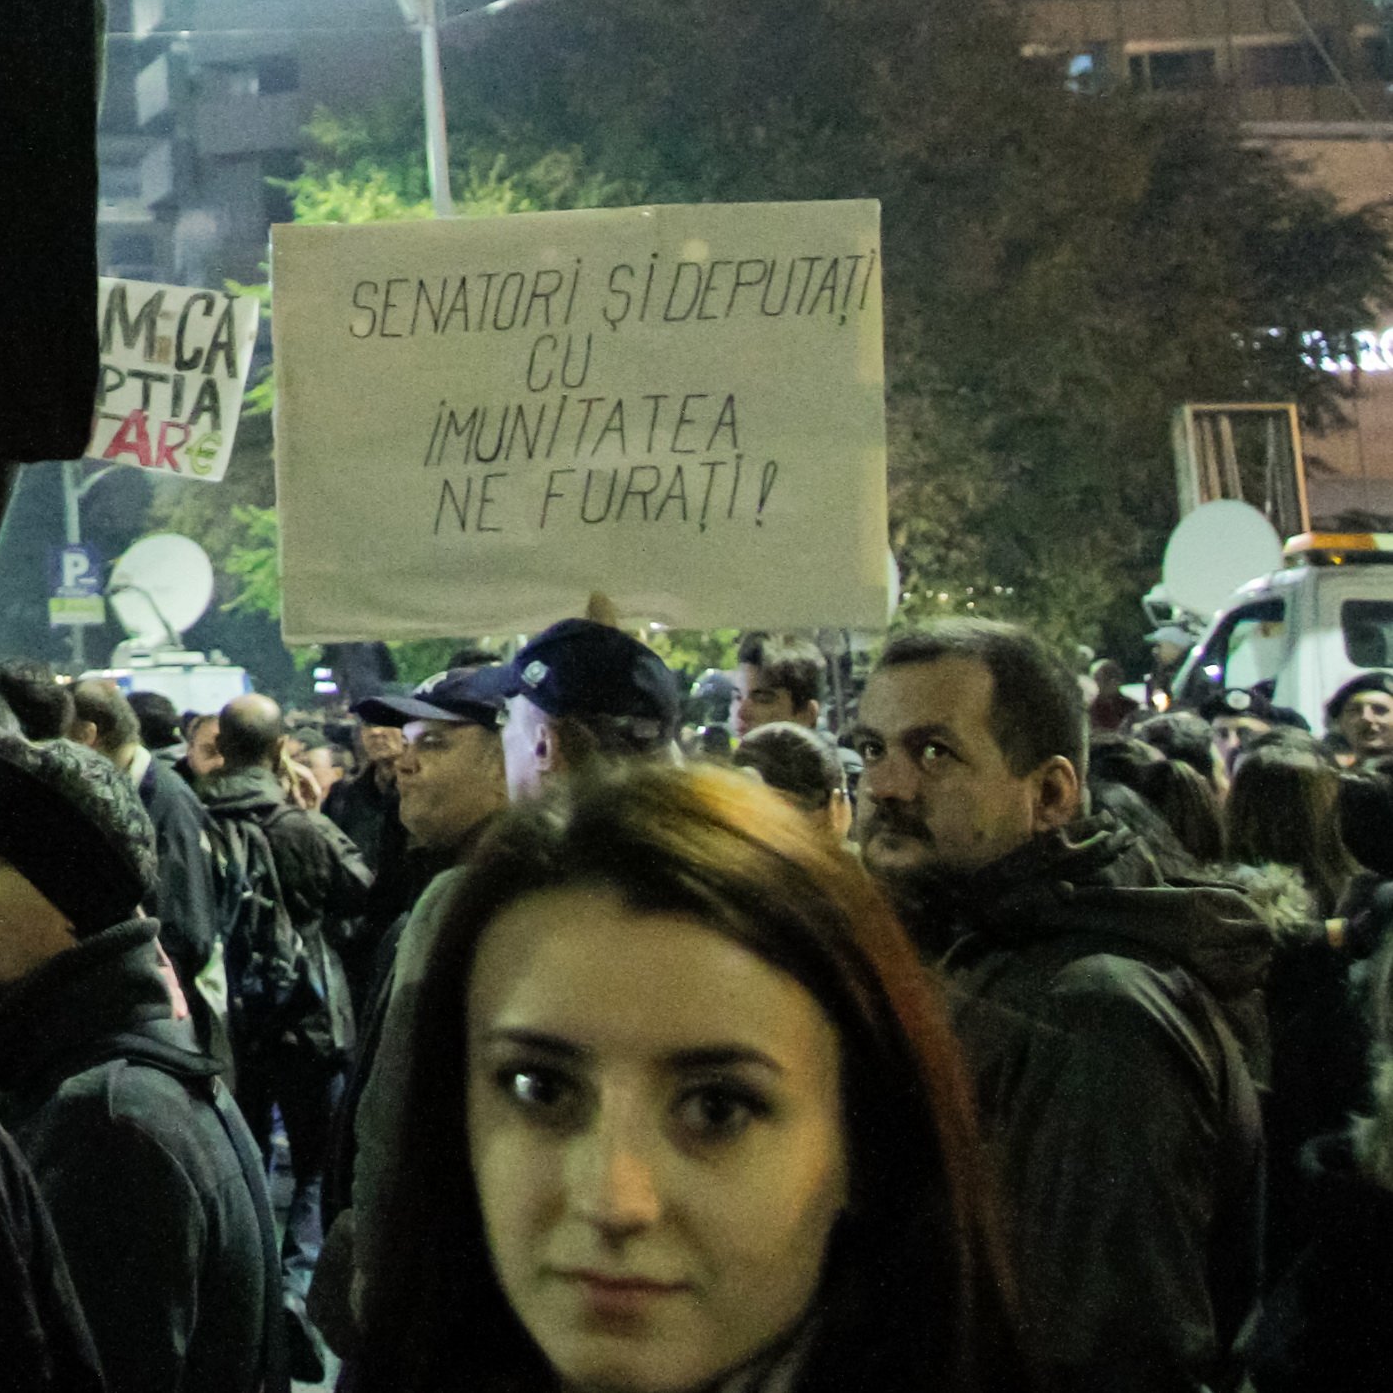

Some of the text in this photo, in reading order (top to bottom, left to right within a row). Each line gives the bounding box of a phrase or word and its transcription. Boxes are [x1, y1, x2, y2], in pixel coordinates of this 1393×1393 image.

[349, 257, 582, 339] SENATORI
[663, 247, 876, 327] DEPUTAȚI
[526, 332, 593, 393] CU
[433, 472, 508, 536] NE
